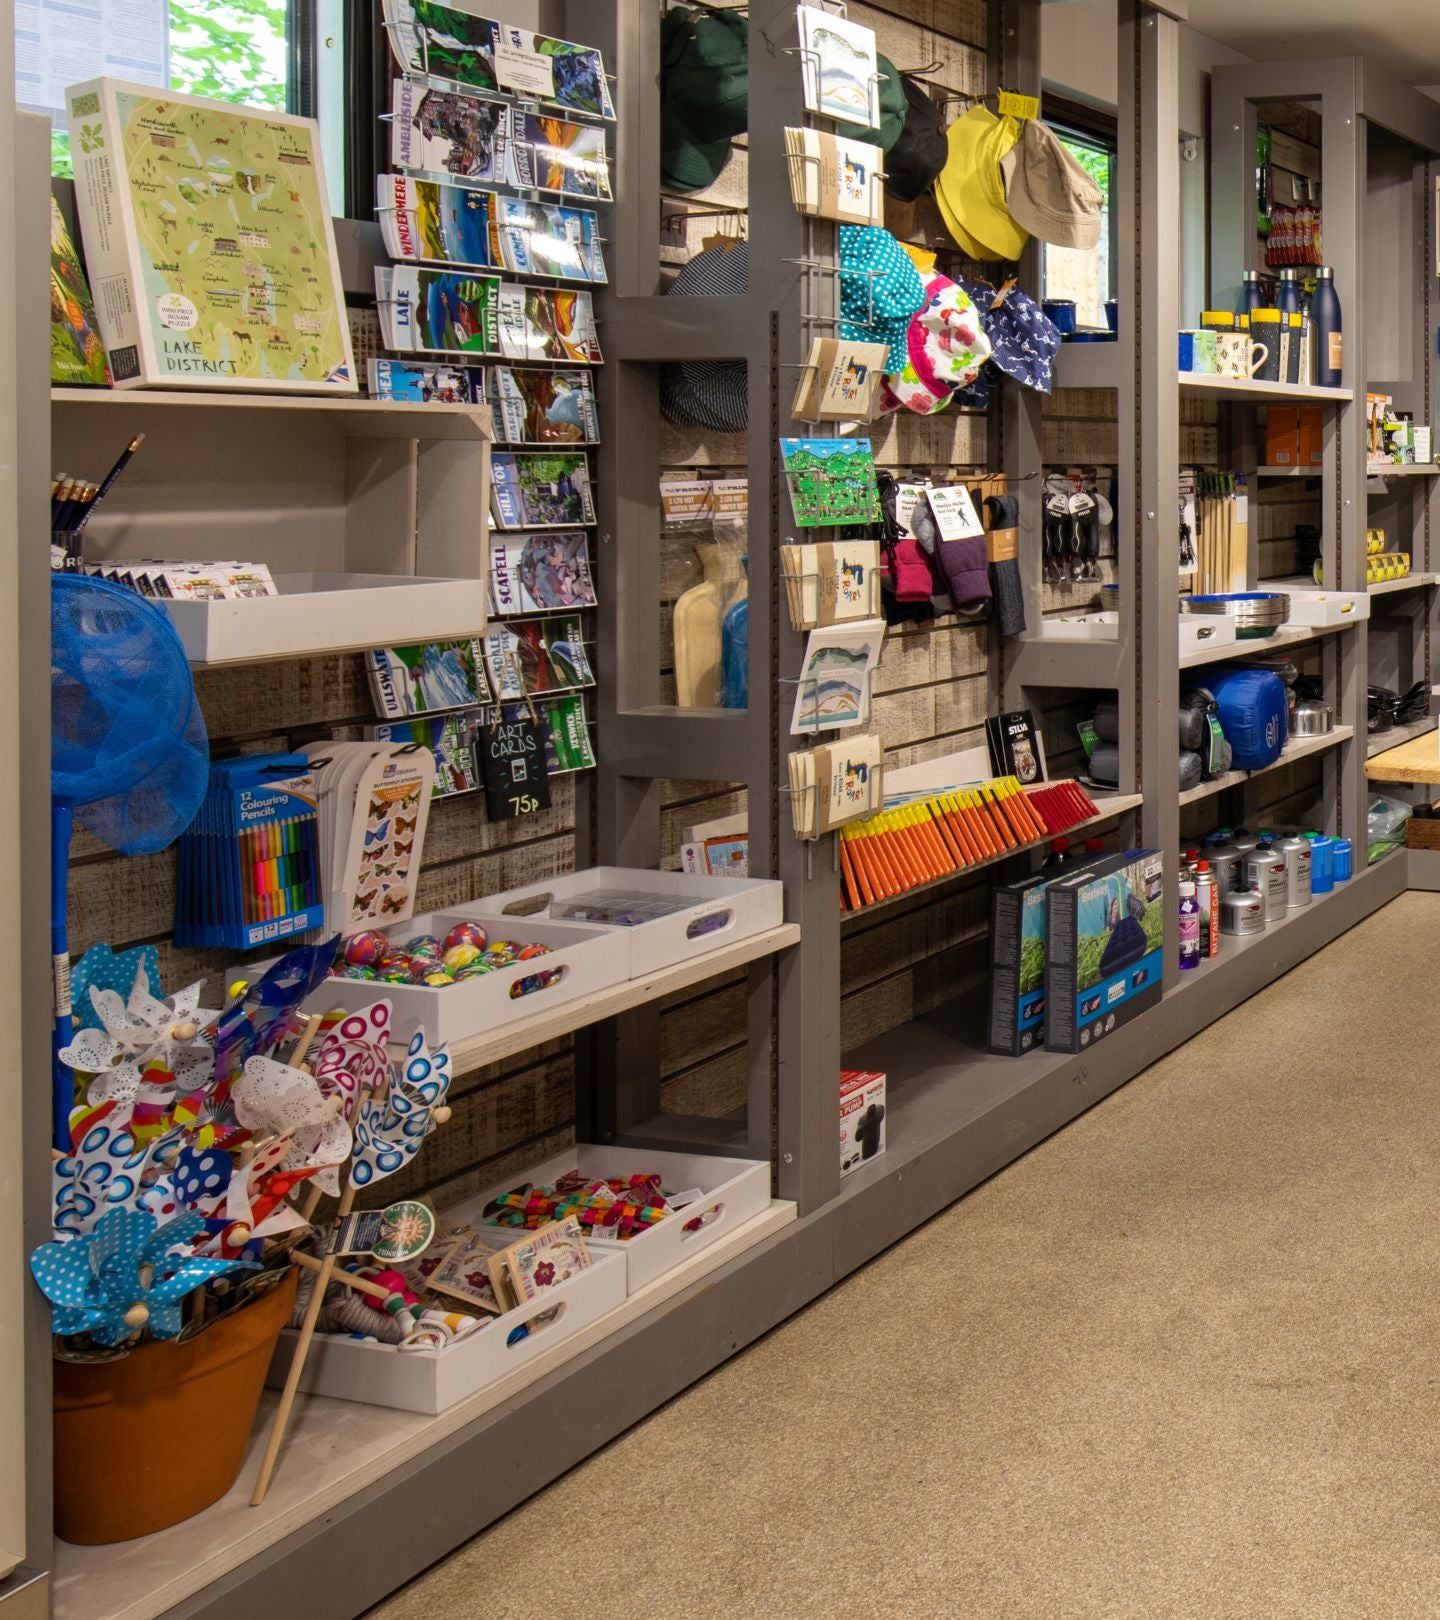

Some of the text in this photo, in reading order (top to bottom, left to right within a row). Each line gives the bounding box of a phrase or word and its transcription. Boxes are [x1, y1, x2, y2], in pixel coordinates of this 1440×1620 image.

[400, 83, 412, 164] AMBLESIDE
[515, 111, 534, 185] BORRODALE
[394, 178, 413, 256] WINDERMERE
[397, 290, 410, 326] LAKE
[164, 340, 202, 356] LAKE
[167, 357, 237, 374] DISTRICT
[501, 488, 514, 518] HILL
[494, 544, 512, 605] SCAFELL
[375, 650, 398, 711] ULLSWATE
[498, 722, 527, 741] ART
[566, 713, 580, 749] KESWICK
[1008, 722, 1028, 736] SILVA
[491, 734, 536, 758] CARDS
[240, 792, 252, 801] 12
[240, 794, 288, 812] Colouring
[508, 794, 539, 816] 75p
[240, 806, 275, 822] Pencils
[1080, 886, 1108, 900] Bestway
